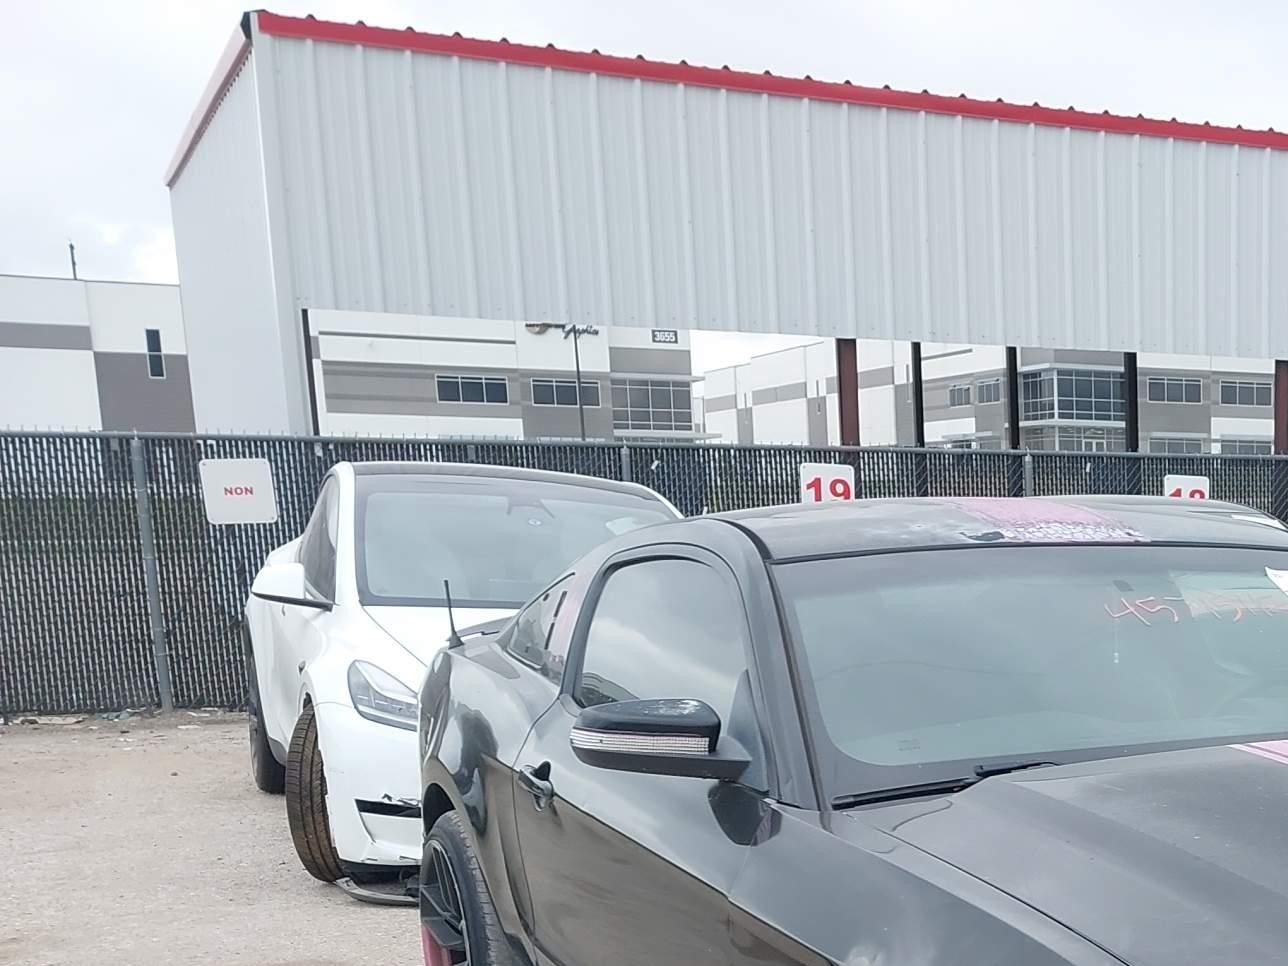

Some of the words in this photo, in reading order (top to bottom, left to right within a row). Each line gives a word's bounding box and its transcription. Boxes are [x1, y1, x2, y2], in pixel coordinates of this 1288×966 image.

[654, 331, 676, 342] 3655
[224, 486, 254, 496] NON
[806, 477, 851, 502] 19
